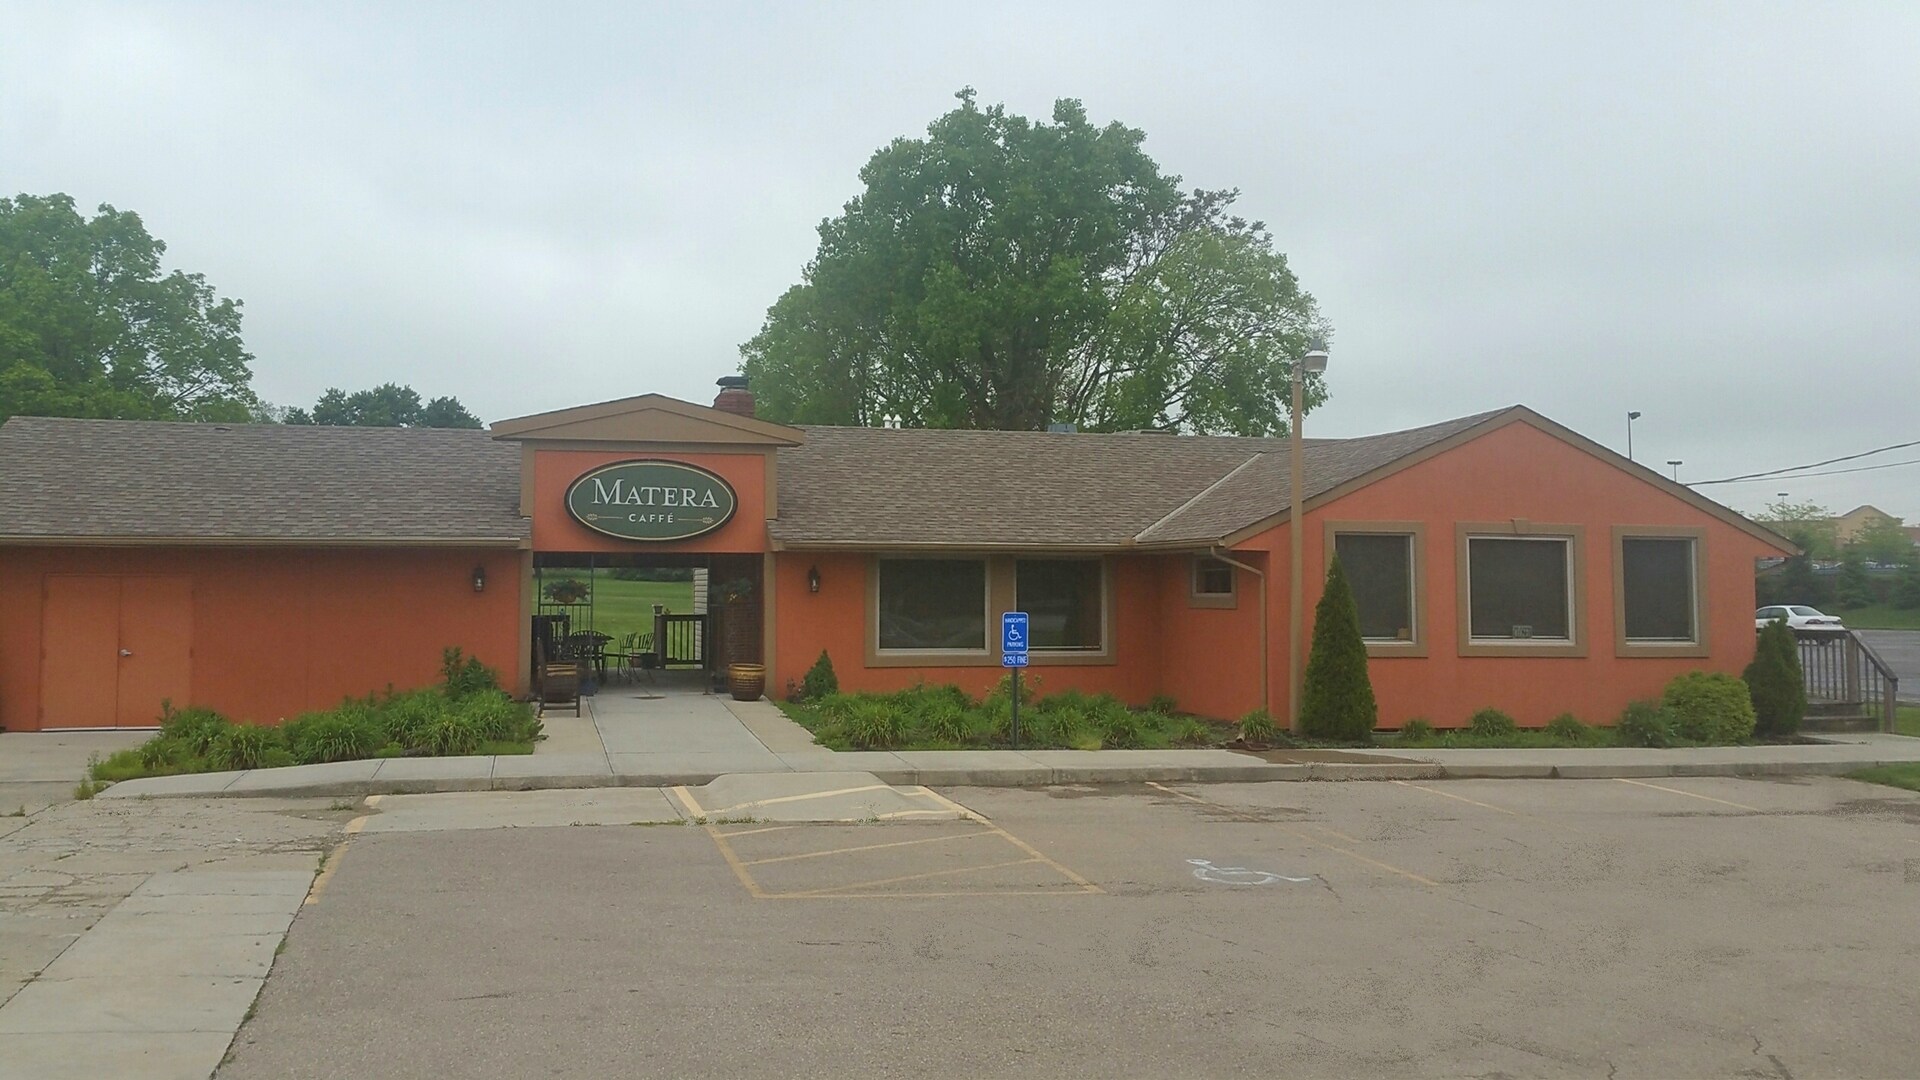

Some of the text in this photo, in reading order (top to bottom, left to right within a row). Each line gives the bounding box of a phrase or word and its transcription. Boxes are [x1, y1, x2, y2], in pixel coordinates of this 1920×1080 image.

[591, 477, 719, 508] MATERA
[629, 512, 674, 523] CAFFÉ
[1017, 656, 1027, 664] FINE
